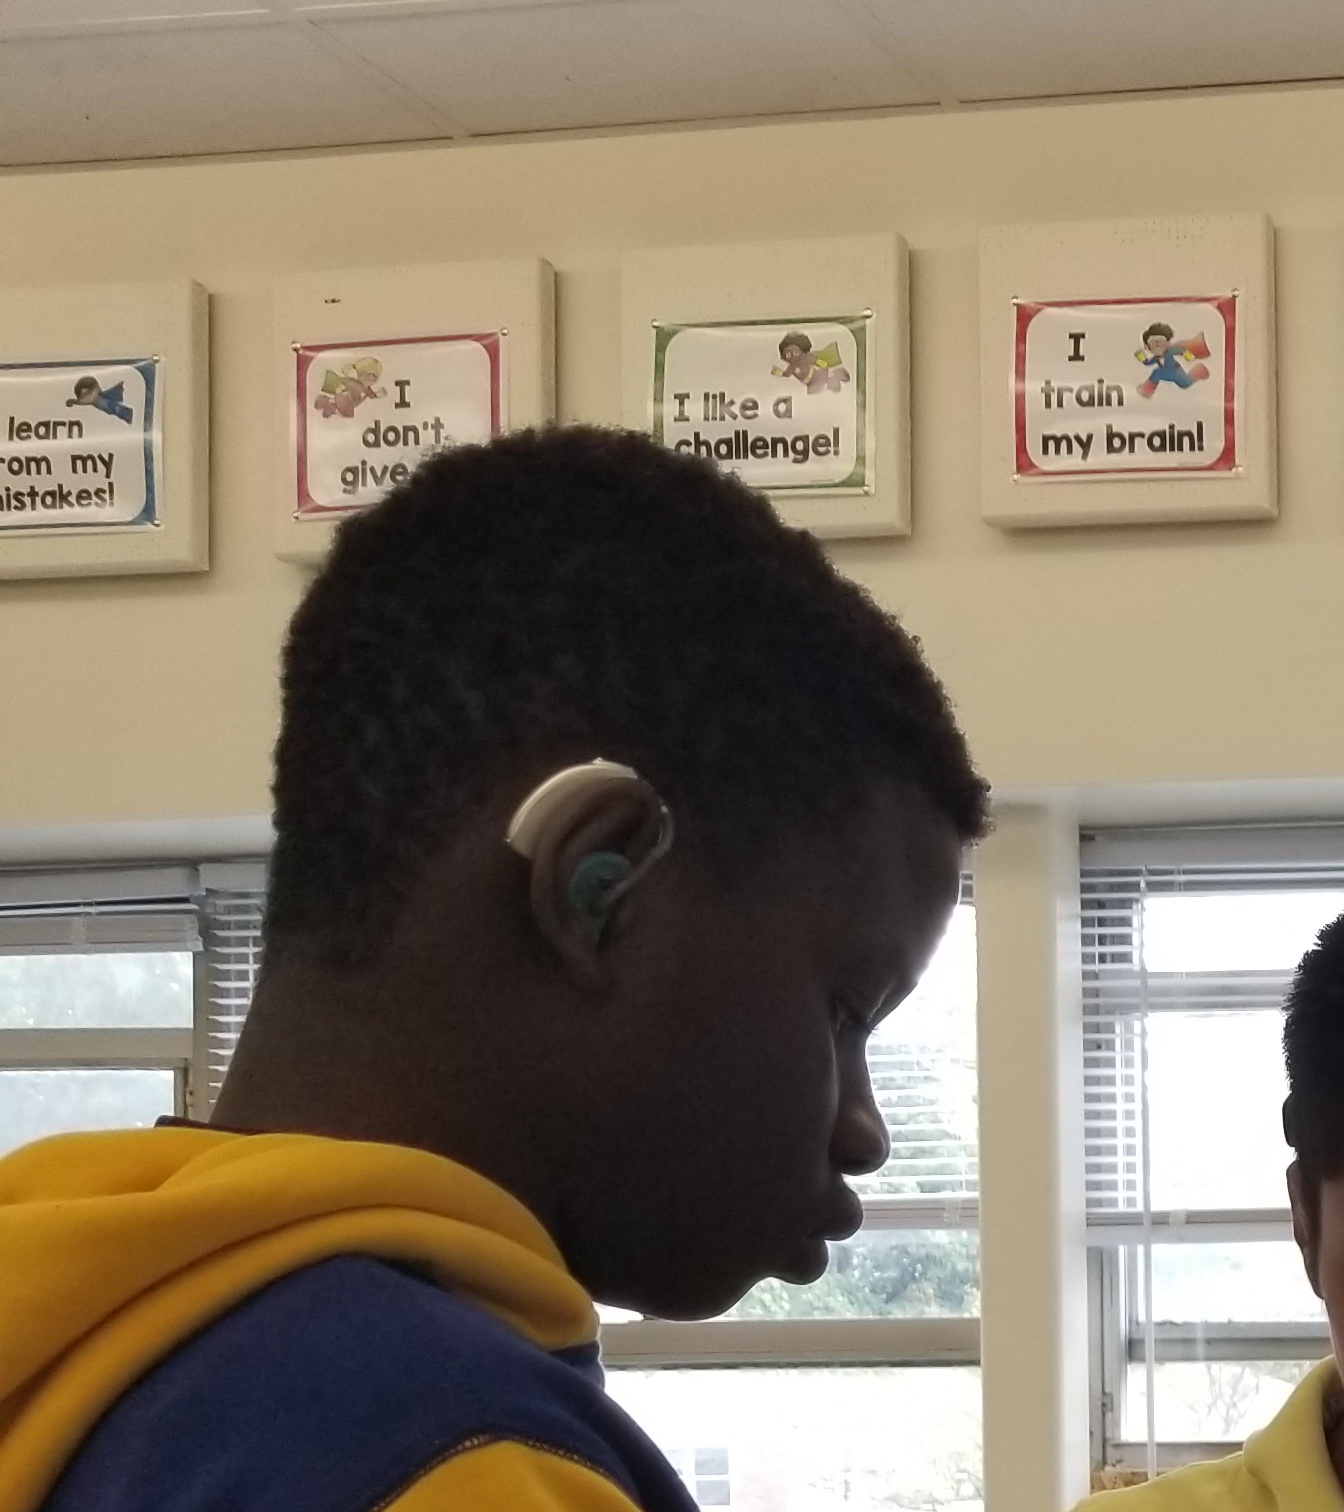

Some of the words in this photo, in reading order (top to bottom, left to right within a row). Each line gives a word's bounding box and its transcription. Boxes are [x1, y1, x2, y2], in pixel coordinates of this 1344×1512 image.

[1067, 332, 1087, 362] I
[394, 379, 411, 409] I
[673, 392, 690, 422] I
[703, 391, 759, 422] like
[773, 396, 793, 419] a
[1040, 379, 1125, 410] train
[8, 416, 84, 442] learn
[362, 417, 445, 448] don't
[1041, 431, 1093, 461] my
[1105, 421, 1205, 455] brain!
[674, 427, 840, 464] challenge!
[71, 452, 114, 479] my
[340, 459, 410, 495] give
[0, 481, 115, 511] istakes!
